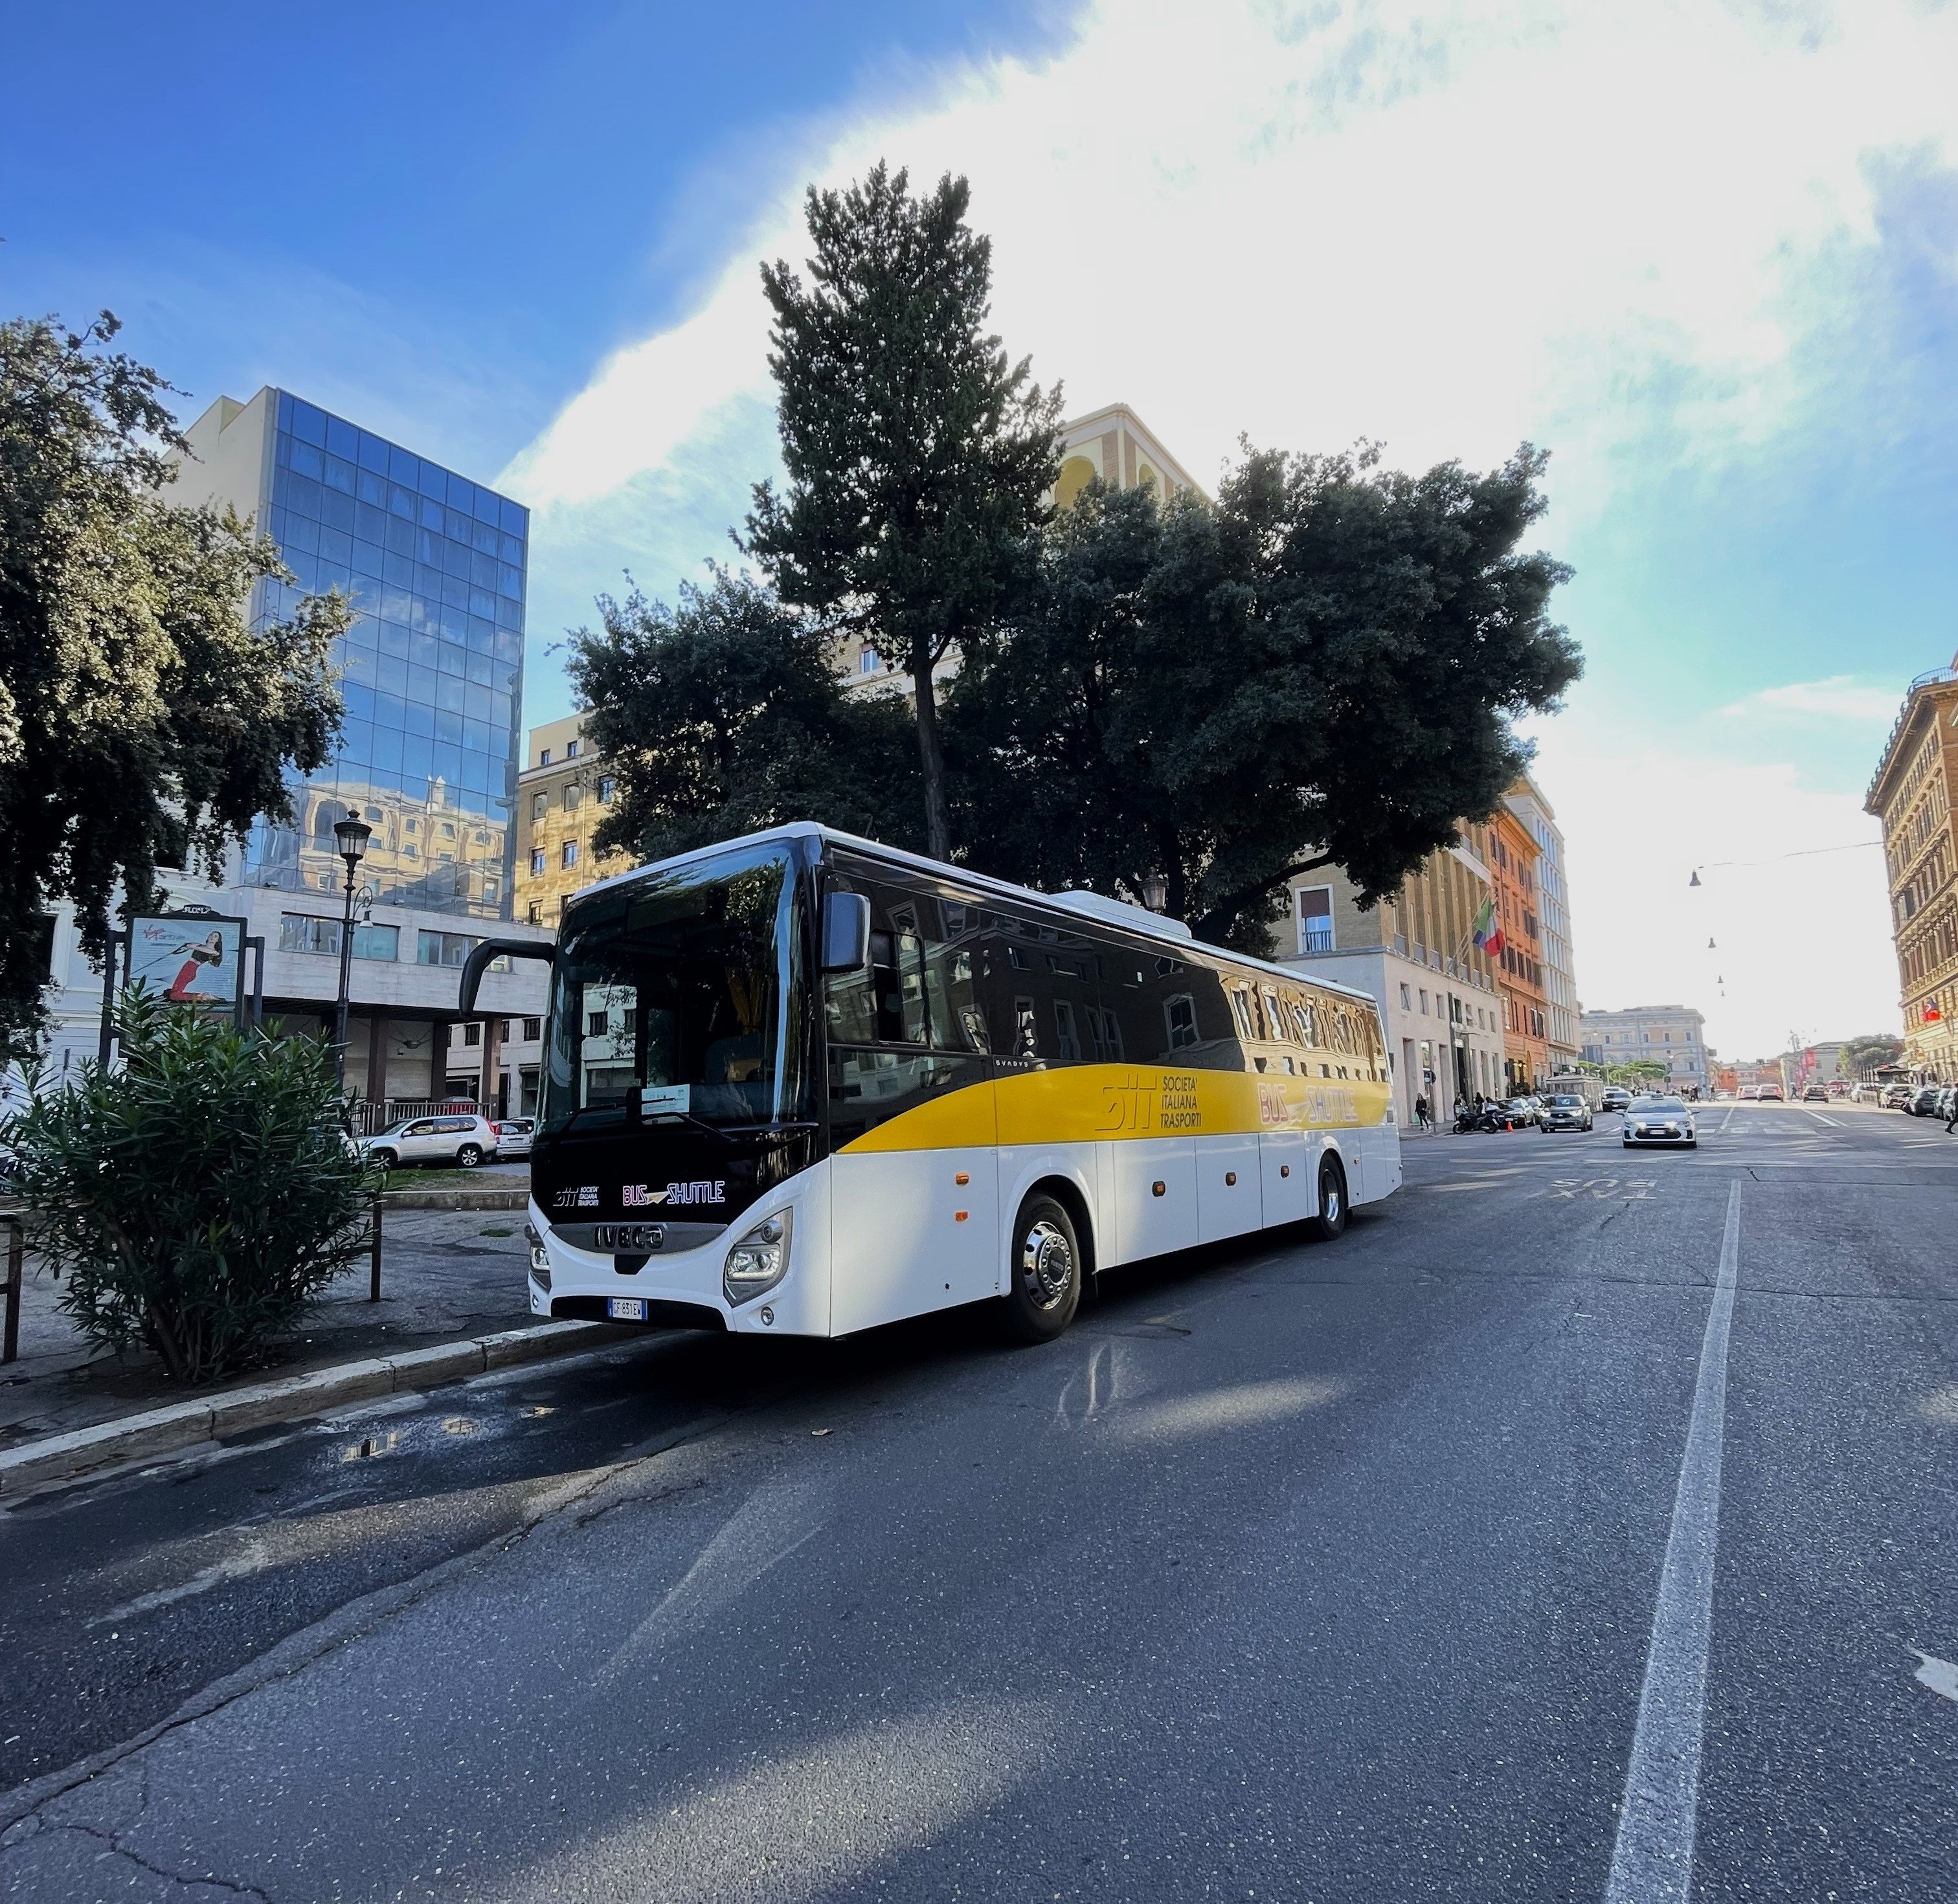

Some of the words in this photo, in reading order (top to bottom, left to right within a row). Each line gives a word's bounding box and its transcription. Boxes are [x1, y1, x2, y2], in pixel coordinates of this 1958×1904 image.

[1162, 1094, 1198, 1110] ITALIANA
[1257, 1082, 1289, 1125] BUS
[1306, 1084, 1358, 1123] SHUTTLE
[1160, 1112, 1202, 1129] TRASPORTI
[622, 1185, 647, 1206] BUS
[666, 1180, 726, 1205] SHUTTLE
[594, 1226, 664, 1249] IVECO
